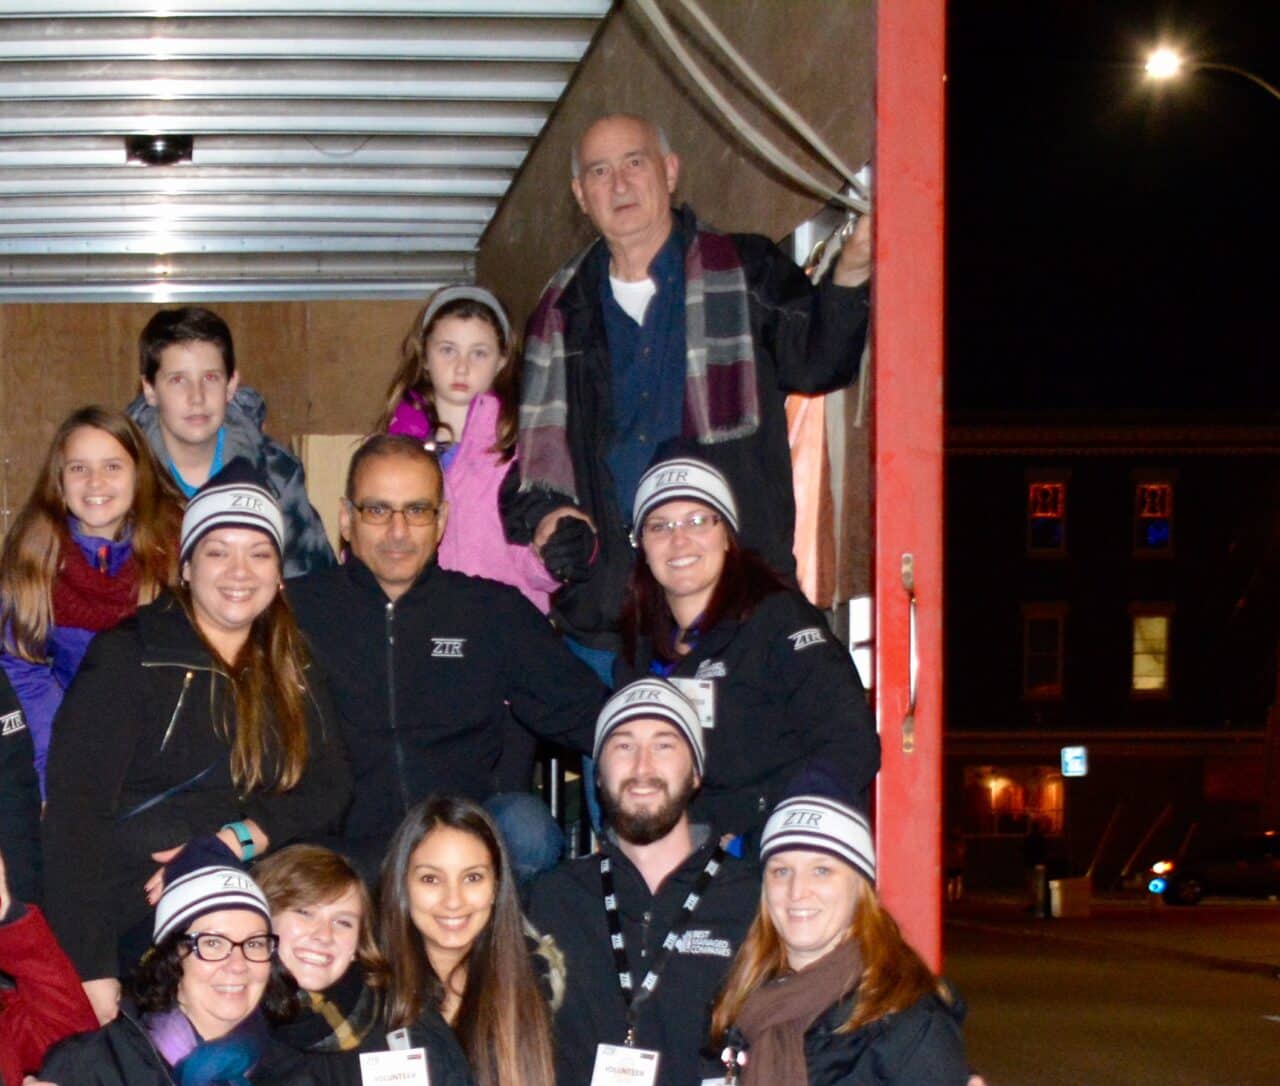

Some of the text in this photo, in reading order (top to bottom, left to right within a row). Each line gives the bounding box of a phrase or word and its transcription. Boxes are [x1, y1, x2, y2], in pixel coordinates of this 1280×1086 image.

[656, 471, 689, 487] ZTR
[231, 495, 263, 512] ZTR
[431, 639, 463, 656] ZTR
[783, 811, 823, 827] ZTR
[374, 1071, 417, 1083] VOLUNTEER
[605, 1065, 644, 1076] VOLUNTEER
